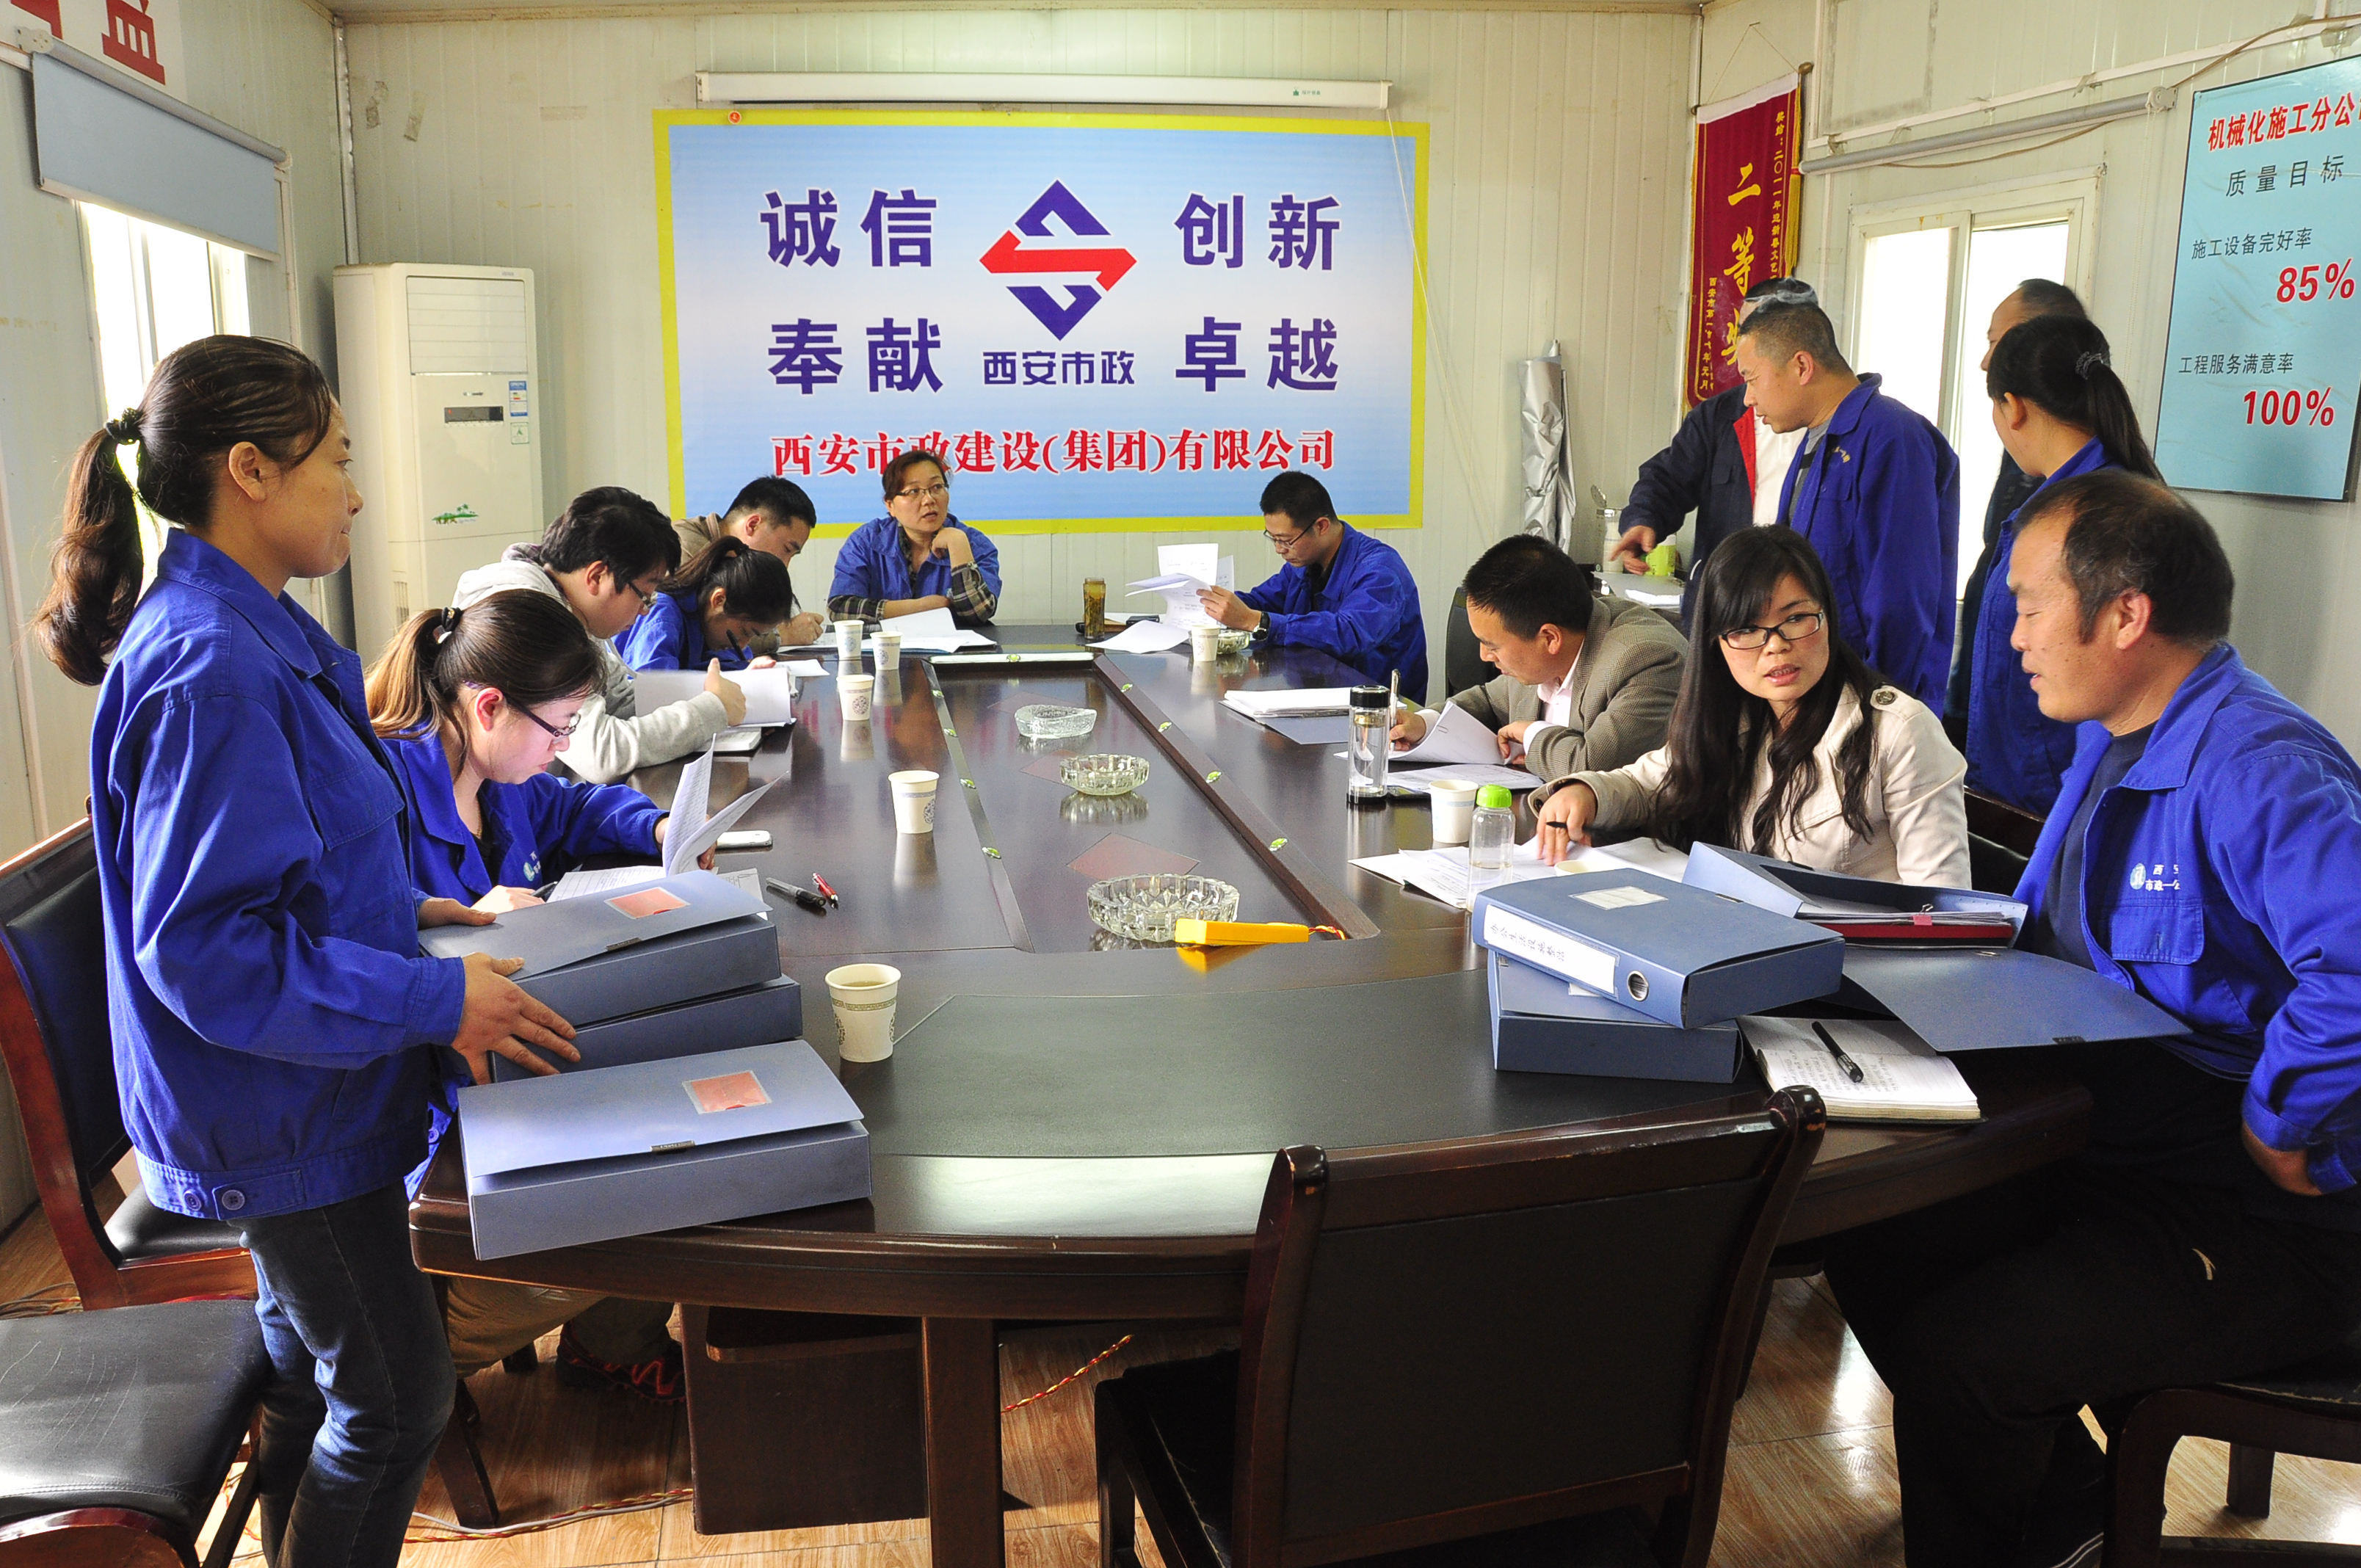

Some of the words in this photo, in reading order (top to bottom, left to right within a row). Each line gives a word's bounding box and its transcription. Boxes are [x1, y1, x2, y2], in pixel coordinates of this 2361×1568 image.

[2208, 92, 2361, 152] 机械化施工分公
[2225, 155, 2345, 197] 质量目标
[760, 187, 937, 268] 诚信
[1174, 192, 1341, 271] 创新
[2191, 227, 2313, 261] 施工设备完好率
[2276, 258, 2356, 303] 85%
[767, 316, 943, 395] 奉献
[982, 349, 1136, 386] 西安市政
[1175, 316, 1339, 393] 卓越
[2177, 352, 2295, 375] 工程服务满意率
[2243, 387, 2335, 427] 100%
[771, 427, 1335, 477] 西安市政建设(集团)有限公司
